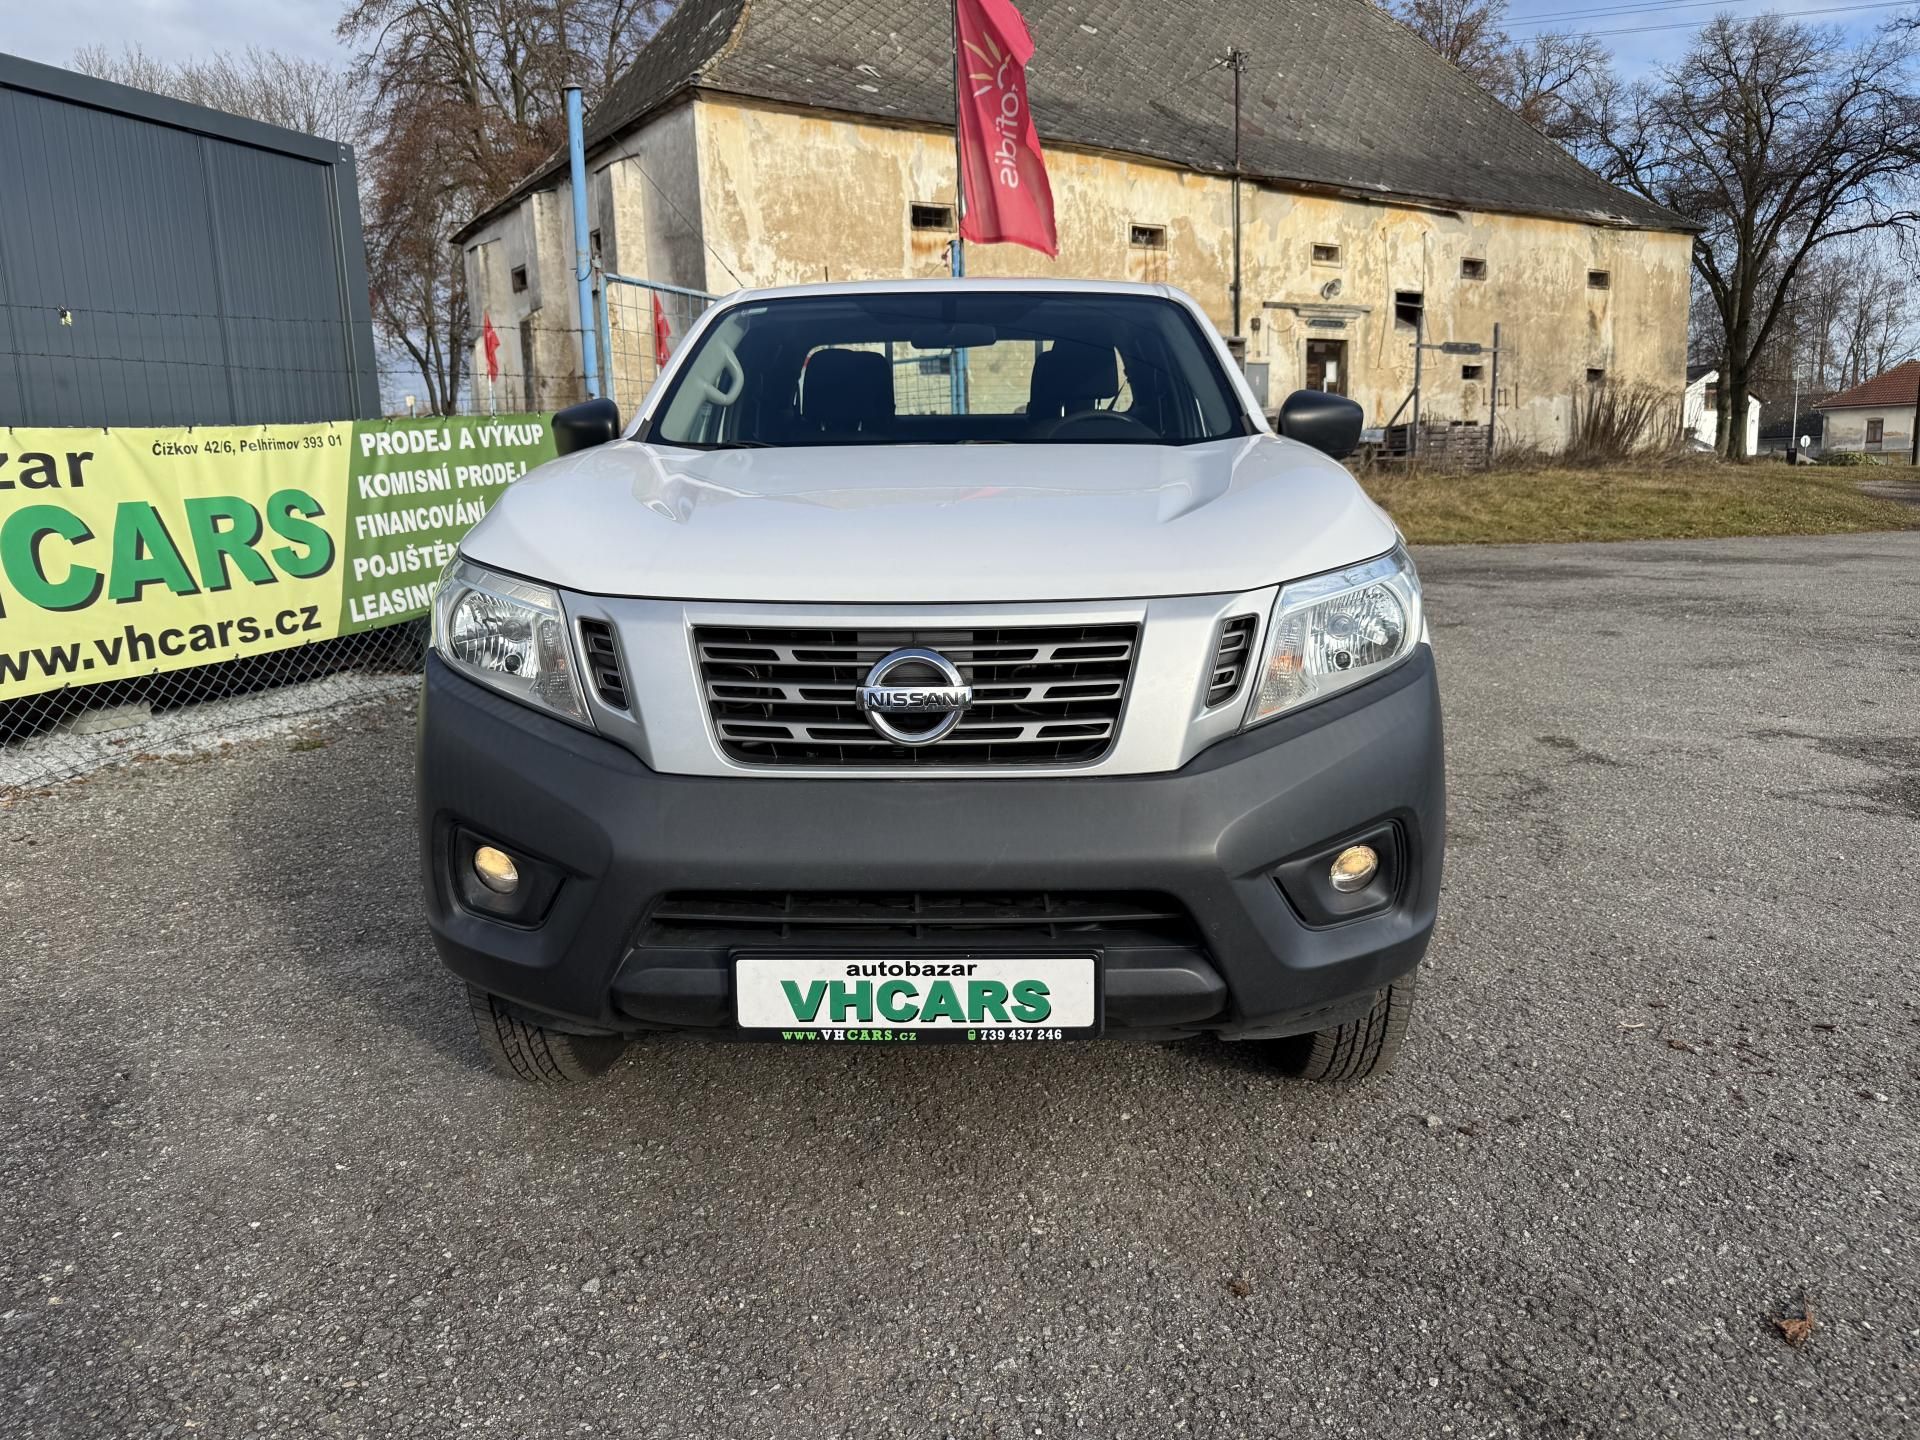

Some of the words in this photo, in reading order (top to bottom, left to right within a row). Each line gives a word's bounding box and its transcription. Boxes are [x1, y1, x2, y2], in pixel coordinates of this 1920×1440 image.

[152, 440, 198, 456] Čížkov
[204, 441, 236, 456] 42/6,
[240, 438, 300, 452] Pelhřimov
[303, 436, 324, 449] 393
[328, 434, 343, 447] 01
[359, 428, 451, 457] PRODEJ
[459, 427, 476, 450] A
[477, 420, 544, 448] VÝKUP
[358, 462, 451, 499] KOMISNÍ
[455, 460, 527, 489] PRODEJ
[355, 495, 486, 540] FINANCOVÁNÍ
[868, 691, 959, 707] NISSAN
[846, 960, 978, 977] autobazar
[780, 979, 1052, 1023] VHCARS
[782, 1029, 917, 1041] www.VHCARS.cz
[981, 1029, 1006, 1040] 739
[1009, 1029, 1034, 1040] 437
[1037, 1029, 1062, 1040] 246
